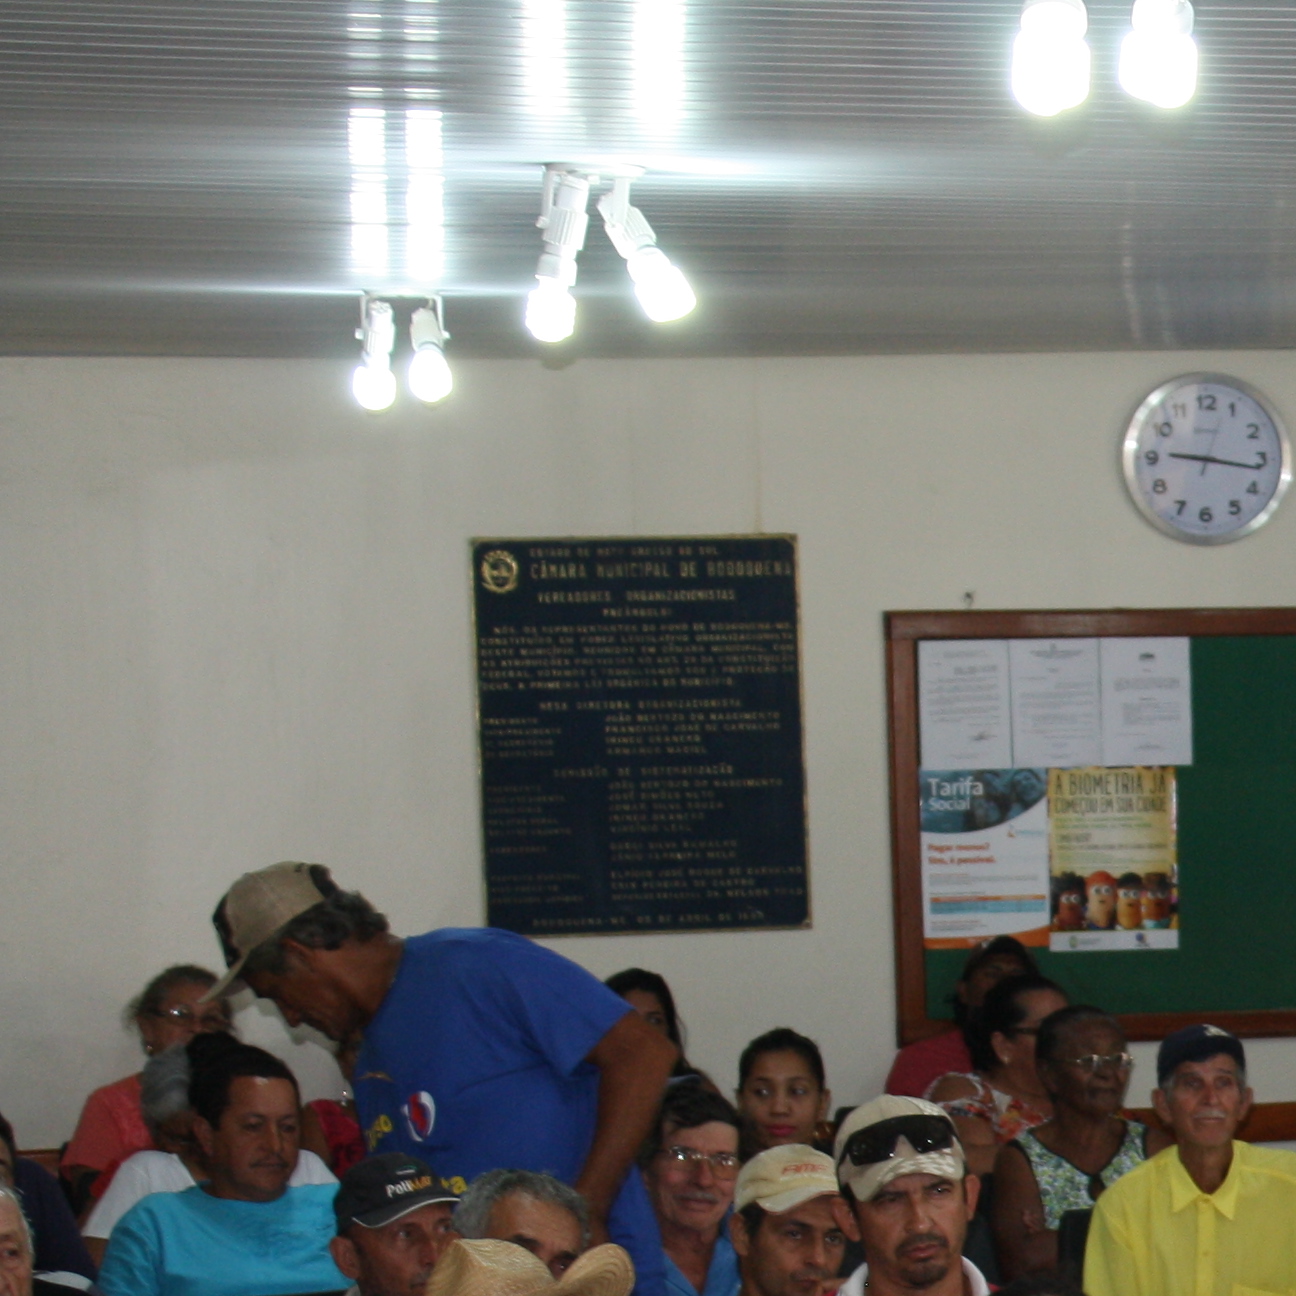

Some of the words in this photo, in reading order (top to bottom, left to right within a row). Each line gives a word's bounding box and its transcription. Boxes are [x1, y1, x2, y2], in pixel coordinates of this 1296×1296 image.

[1197, 395, 1216, 410] 12
[1229, 402, 1236, 417] 1
[1172, 403, 1186, 418] 11
[1154, 422, 1172, 437] 10
[1246, 423, 1259, 439] 2
[1145, 451, 1159, 465] 9
[1255, 452, 1267, 470] 3
[1153, 479, 1167, 494] 8
[1246, 481, 1259, 494] 4
[1174, 500, 1186, 515] 7
[1199, 507, 1213, 522] 6
[1228, 500, 1241, 515] 5
[531, 562, 585, 579] CÂMARA
[680, 561, 696, 577] DE
[927, 777, 984, 796] Tarifa
[1055, 774, 1061, 795] A
[1069, 773, 1144, 796] BIOMETRIA
[1150, 770, 1166, 795] JÁ
[928, 797, 970, 811] Social
